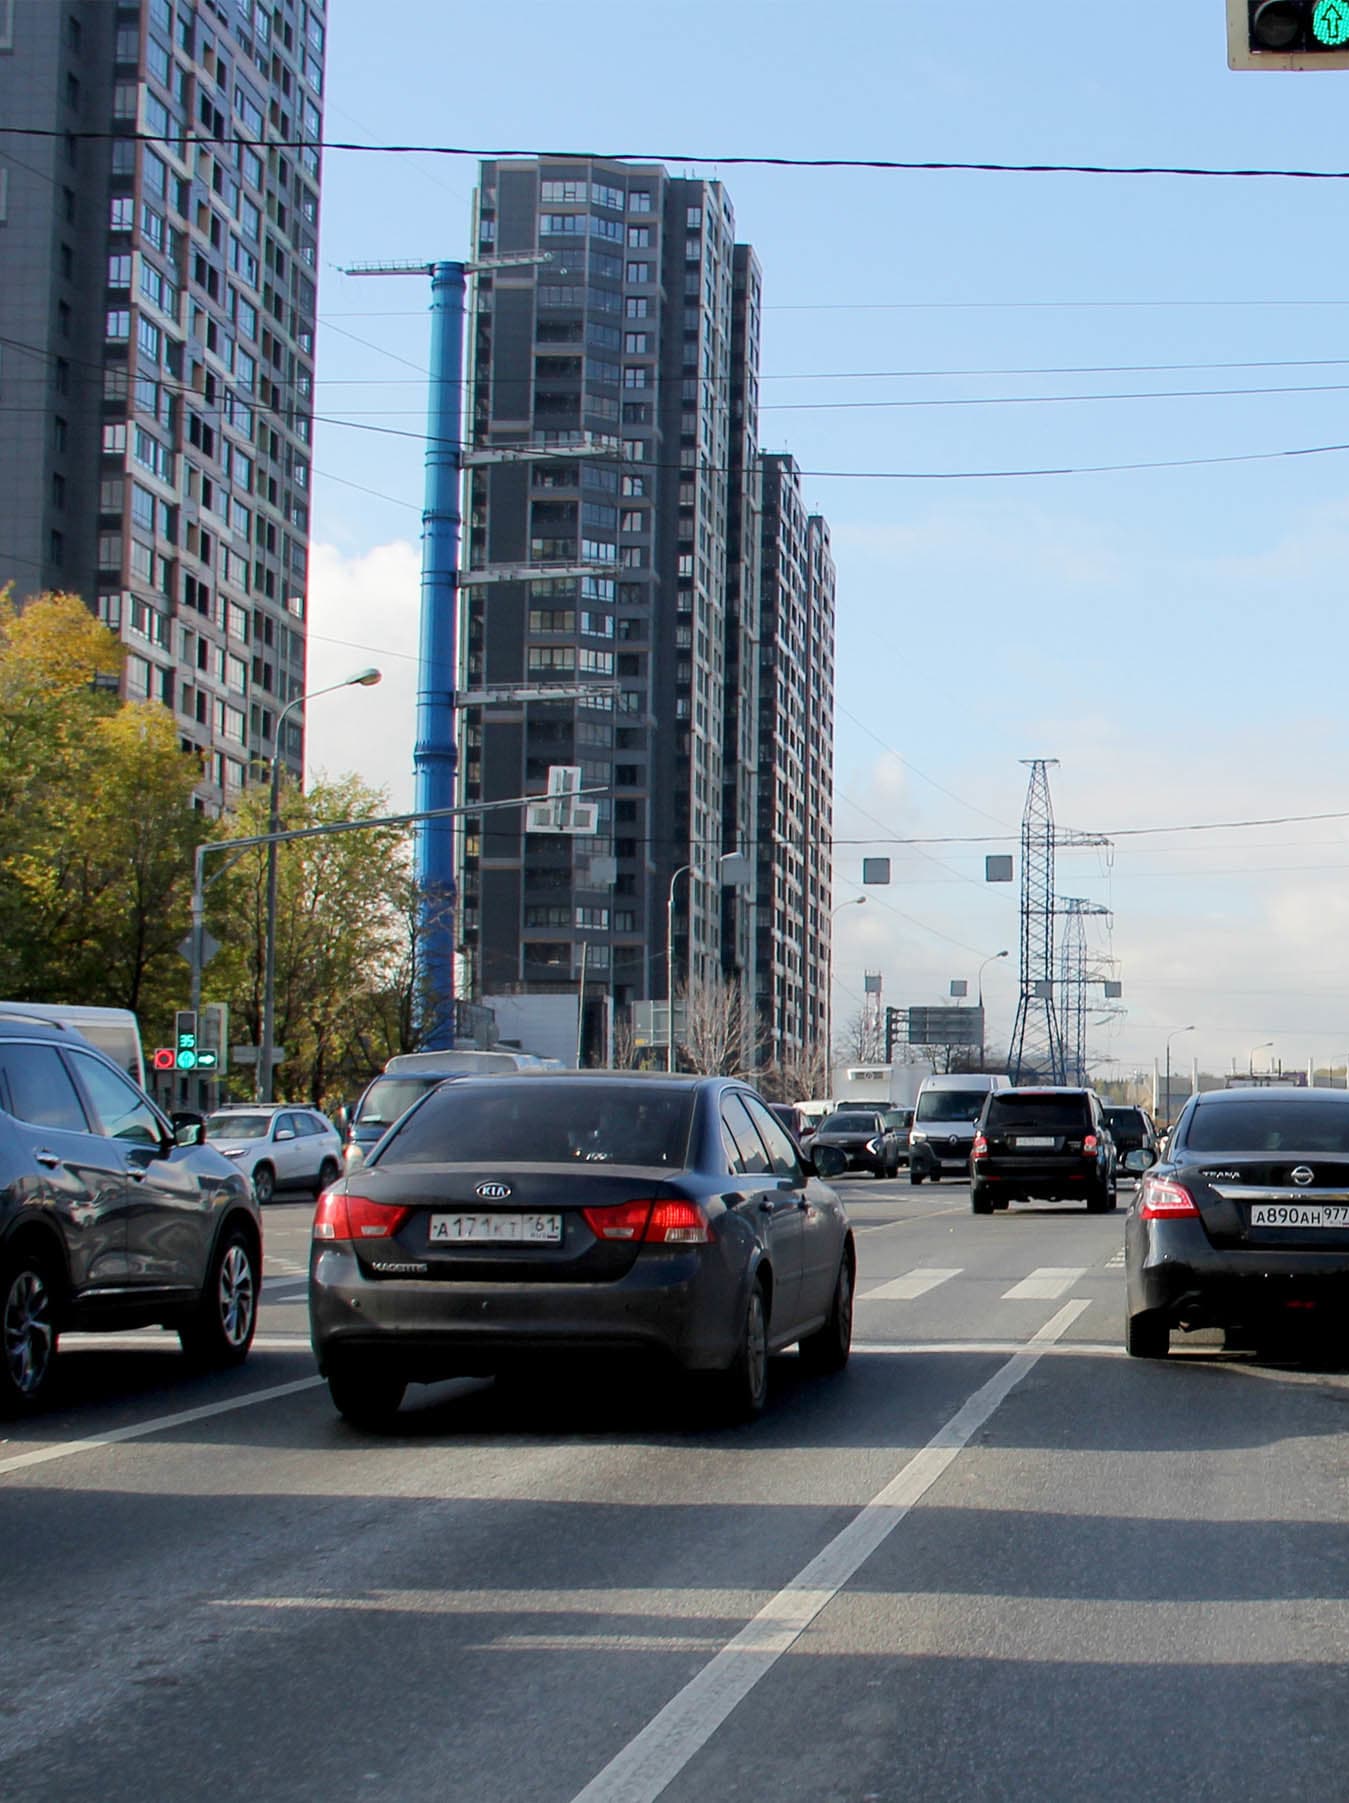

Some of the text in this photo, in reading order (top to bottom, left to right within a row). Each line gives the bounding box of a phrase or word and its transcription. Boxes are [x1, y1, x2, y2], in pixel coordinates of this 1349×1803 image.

[482, 1186, 505, 1196] KIA
[1256, 1207, 1348, 1224] А890АН 977
